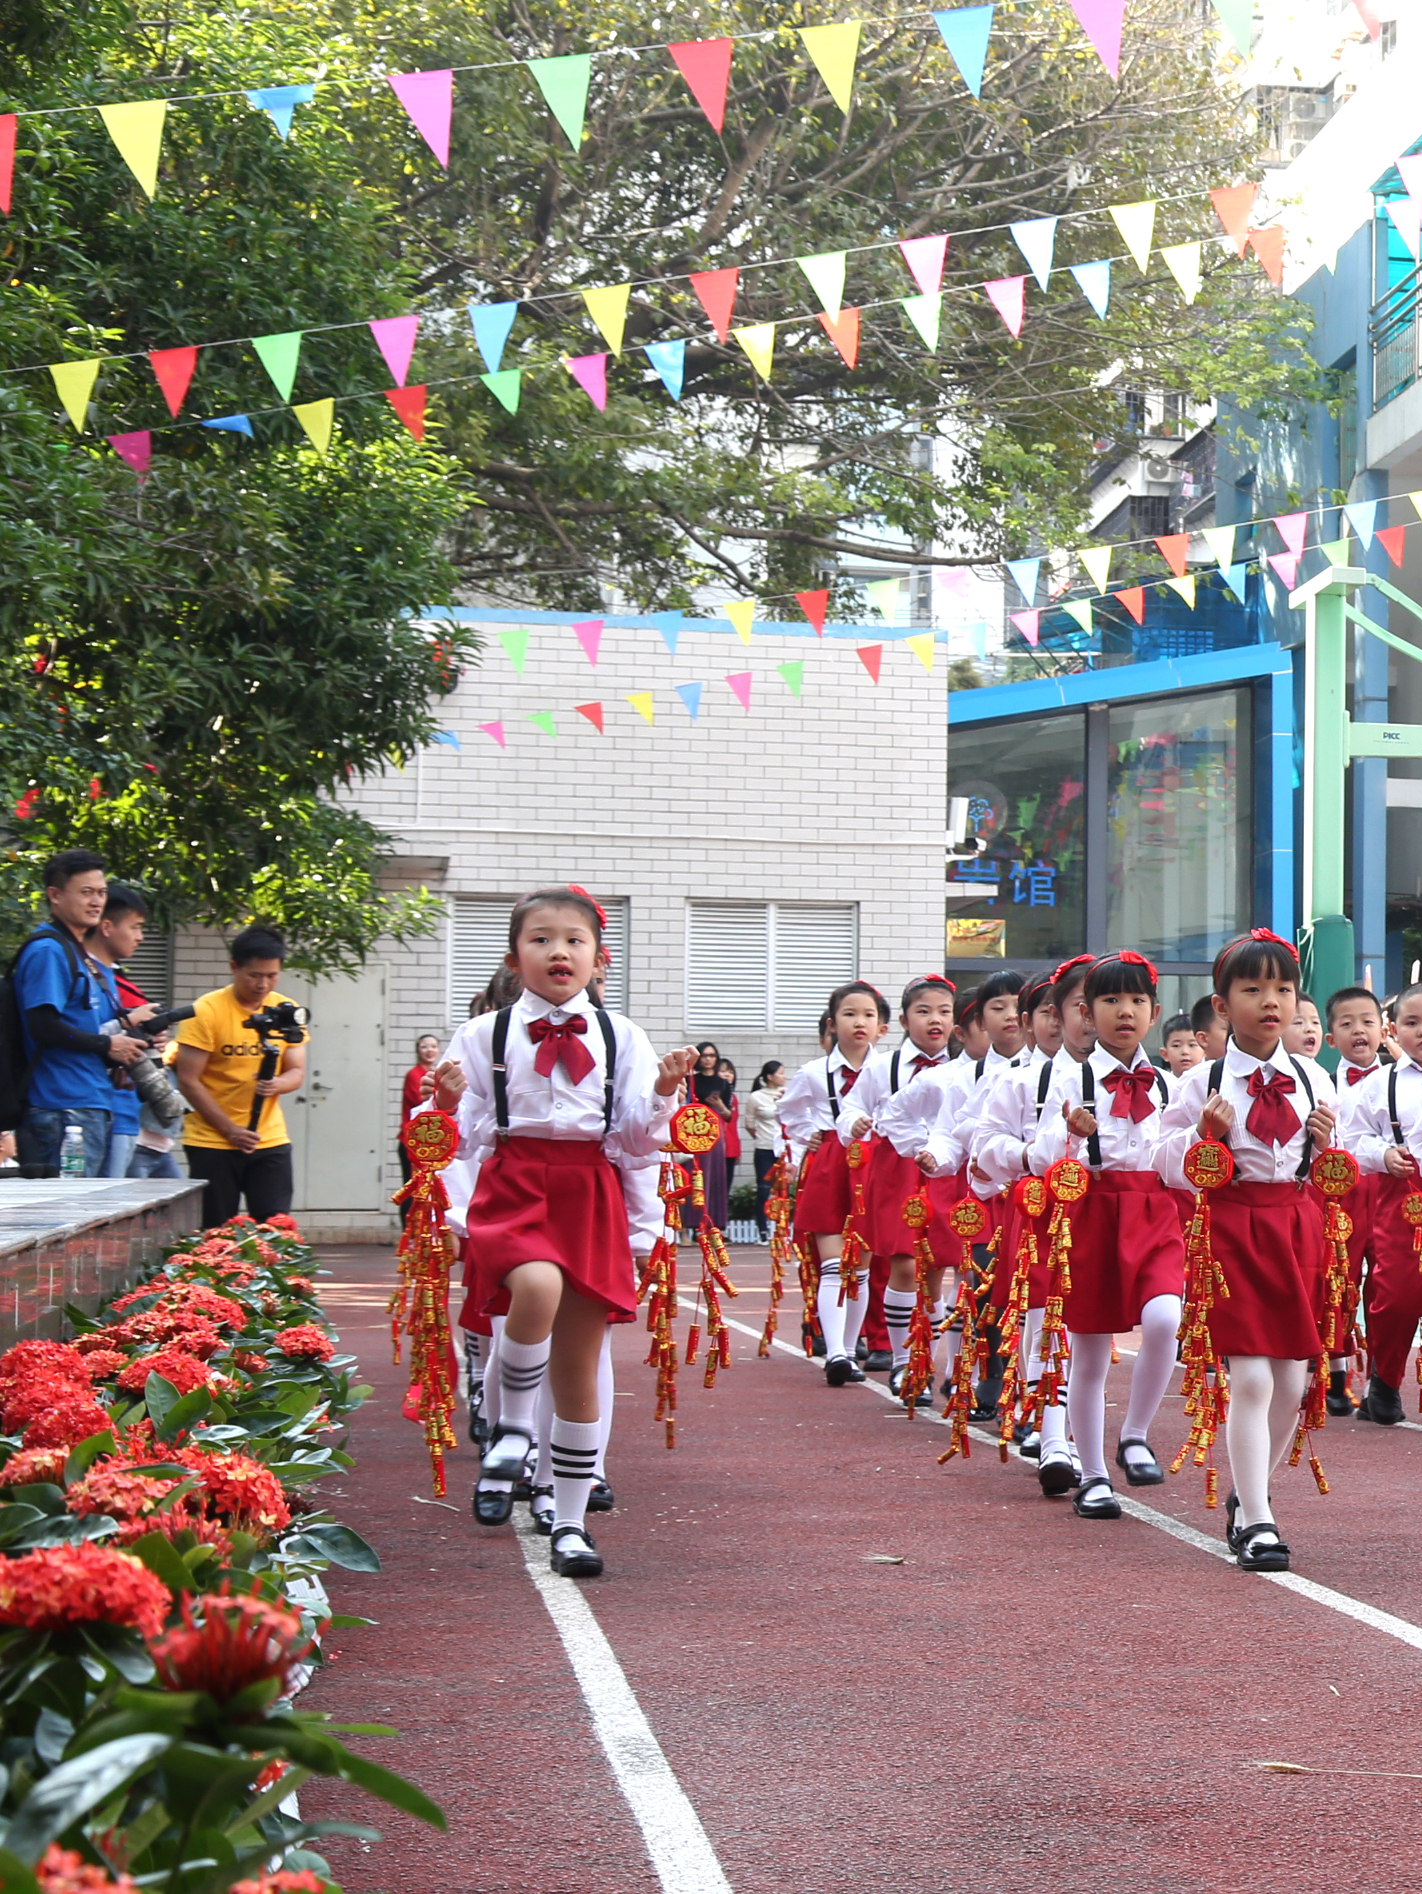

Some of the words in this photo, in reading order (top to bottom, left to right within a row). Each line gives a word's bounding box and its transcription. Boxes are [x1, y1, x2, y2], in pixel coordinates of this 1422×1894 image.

[1383, 731, 1401, 740] PICC
[221, 1042, 279, 1057] adid
[414, 1114, 444, 1143] 福
[684, 1108, 710, 1134] 福
[1322, 1154, 1347, 1178] 福
[956, 1203, 978, 1223] 福
